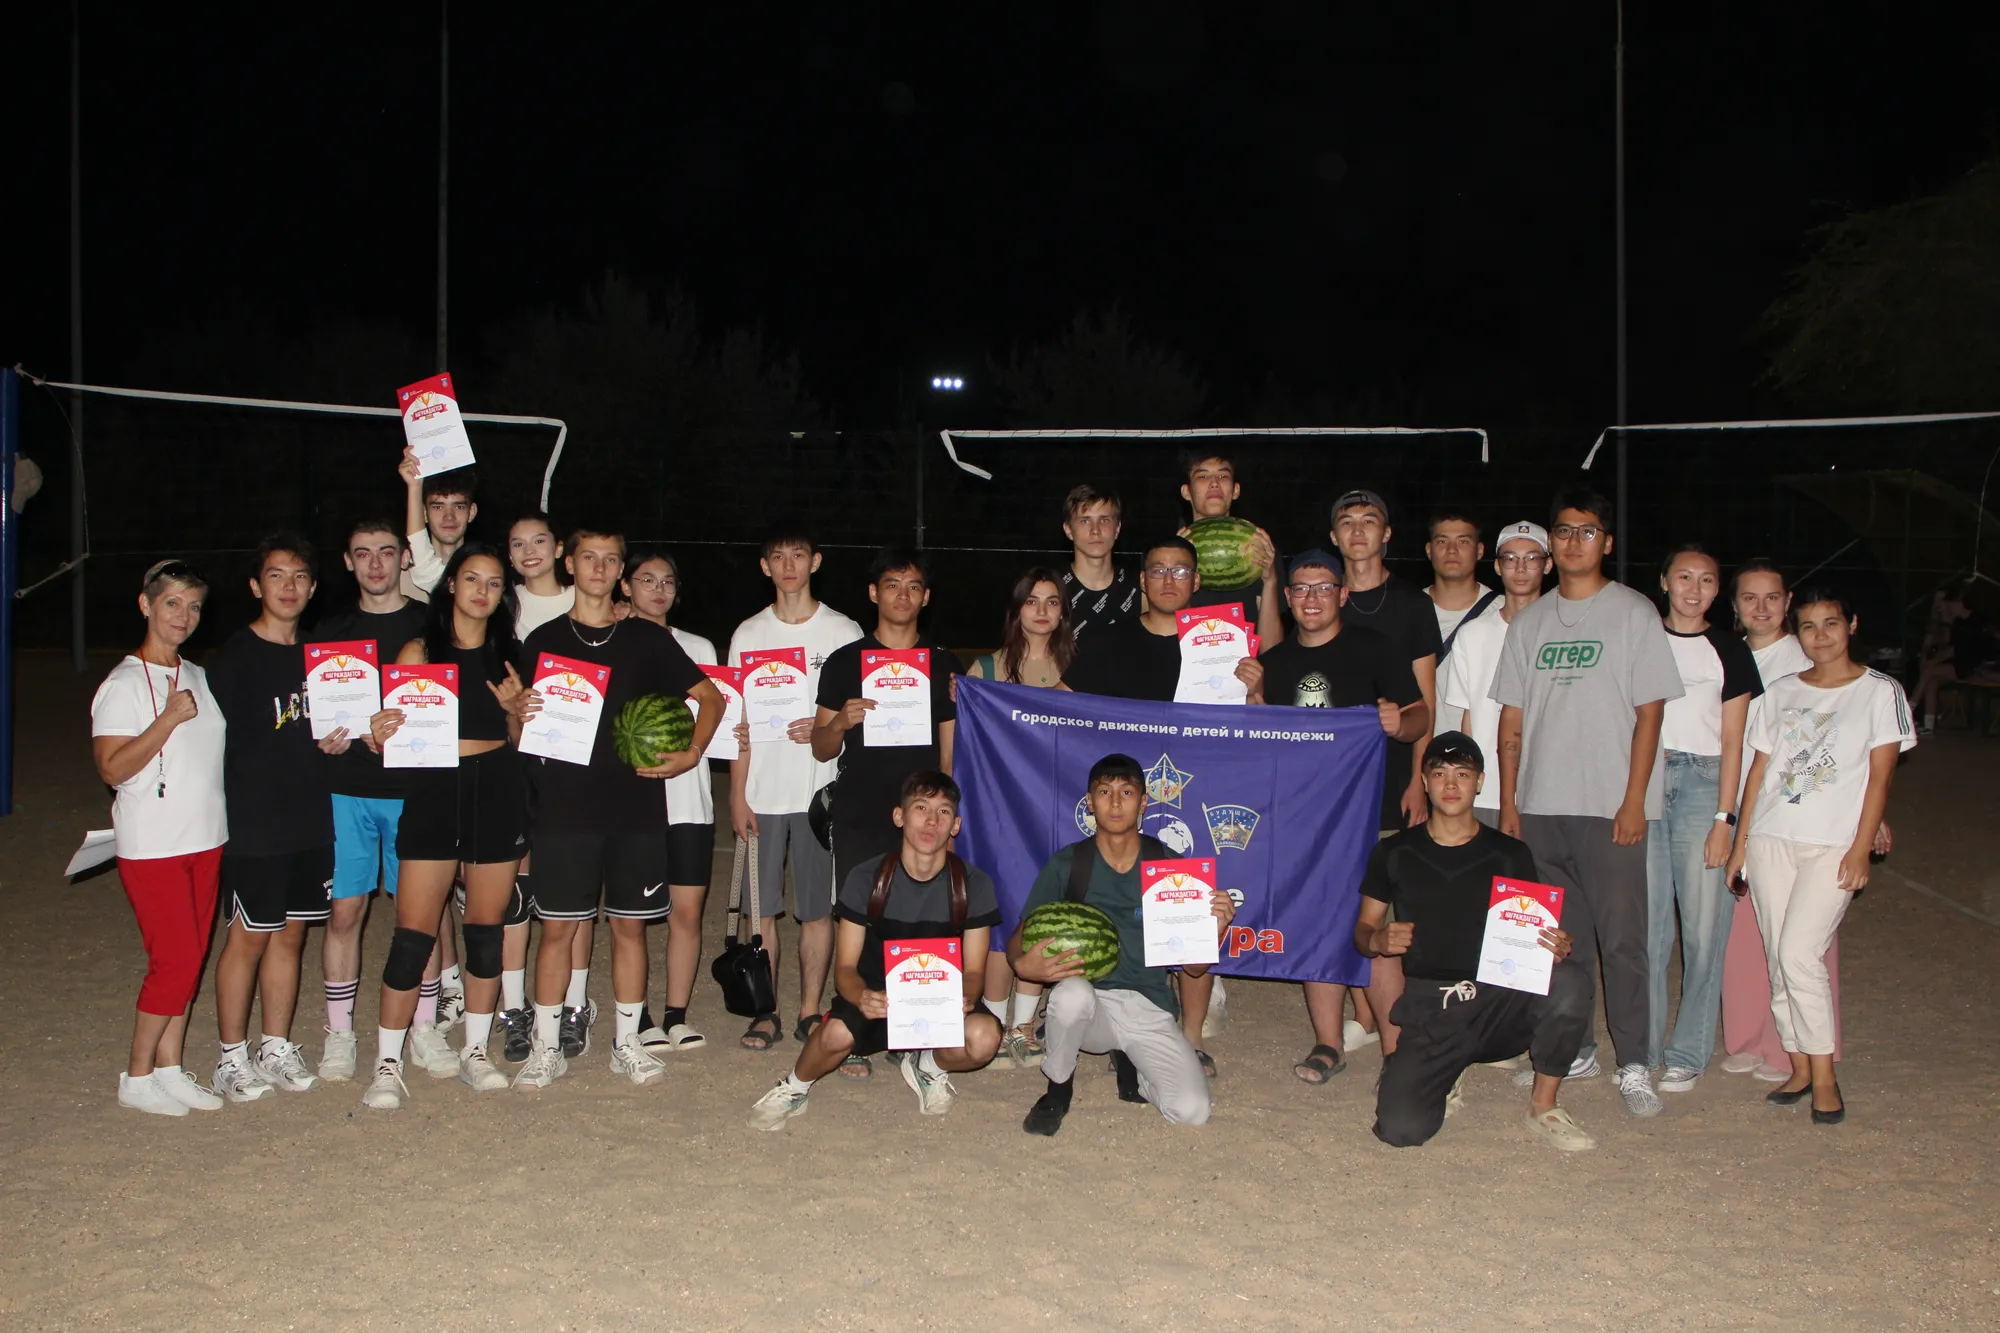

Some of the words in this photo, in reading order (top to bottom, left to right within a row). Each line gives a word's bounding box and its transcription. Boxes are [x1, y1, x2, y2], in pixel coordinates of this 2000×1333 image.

[1196, 633, 1230, 643] НАГРАЖДАЕТСЯ
[325, 671, 361, 679] НАГРАЖДАЕТСЯ
[759, 675, 791, 684] НАГРАЖДАЕТСЯ
[550, 686, 587, 699] НАГРАЖДАЕТСЯ
[1011, 709, 1094, 728] Городское
[1098, 720, 1178, 735] движение
[1182, 726, 1229, 738] детей
[1233, 729, 1244, 738] и
[1249, 730, 1335, 742] молодежи
[1160, 890, 1198, 899] НАГРАЖДАЕТСЯ
[1504, 911, 1540, 924] НАГРАЖДАЕТСЯ
[905, 971, 943, 979] НАГРАЖДАЕТСЯ
